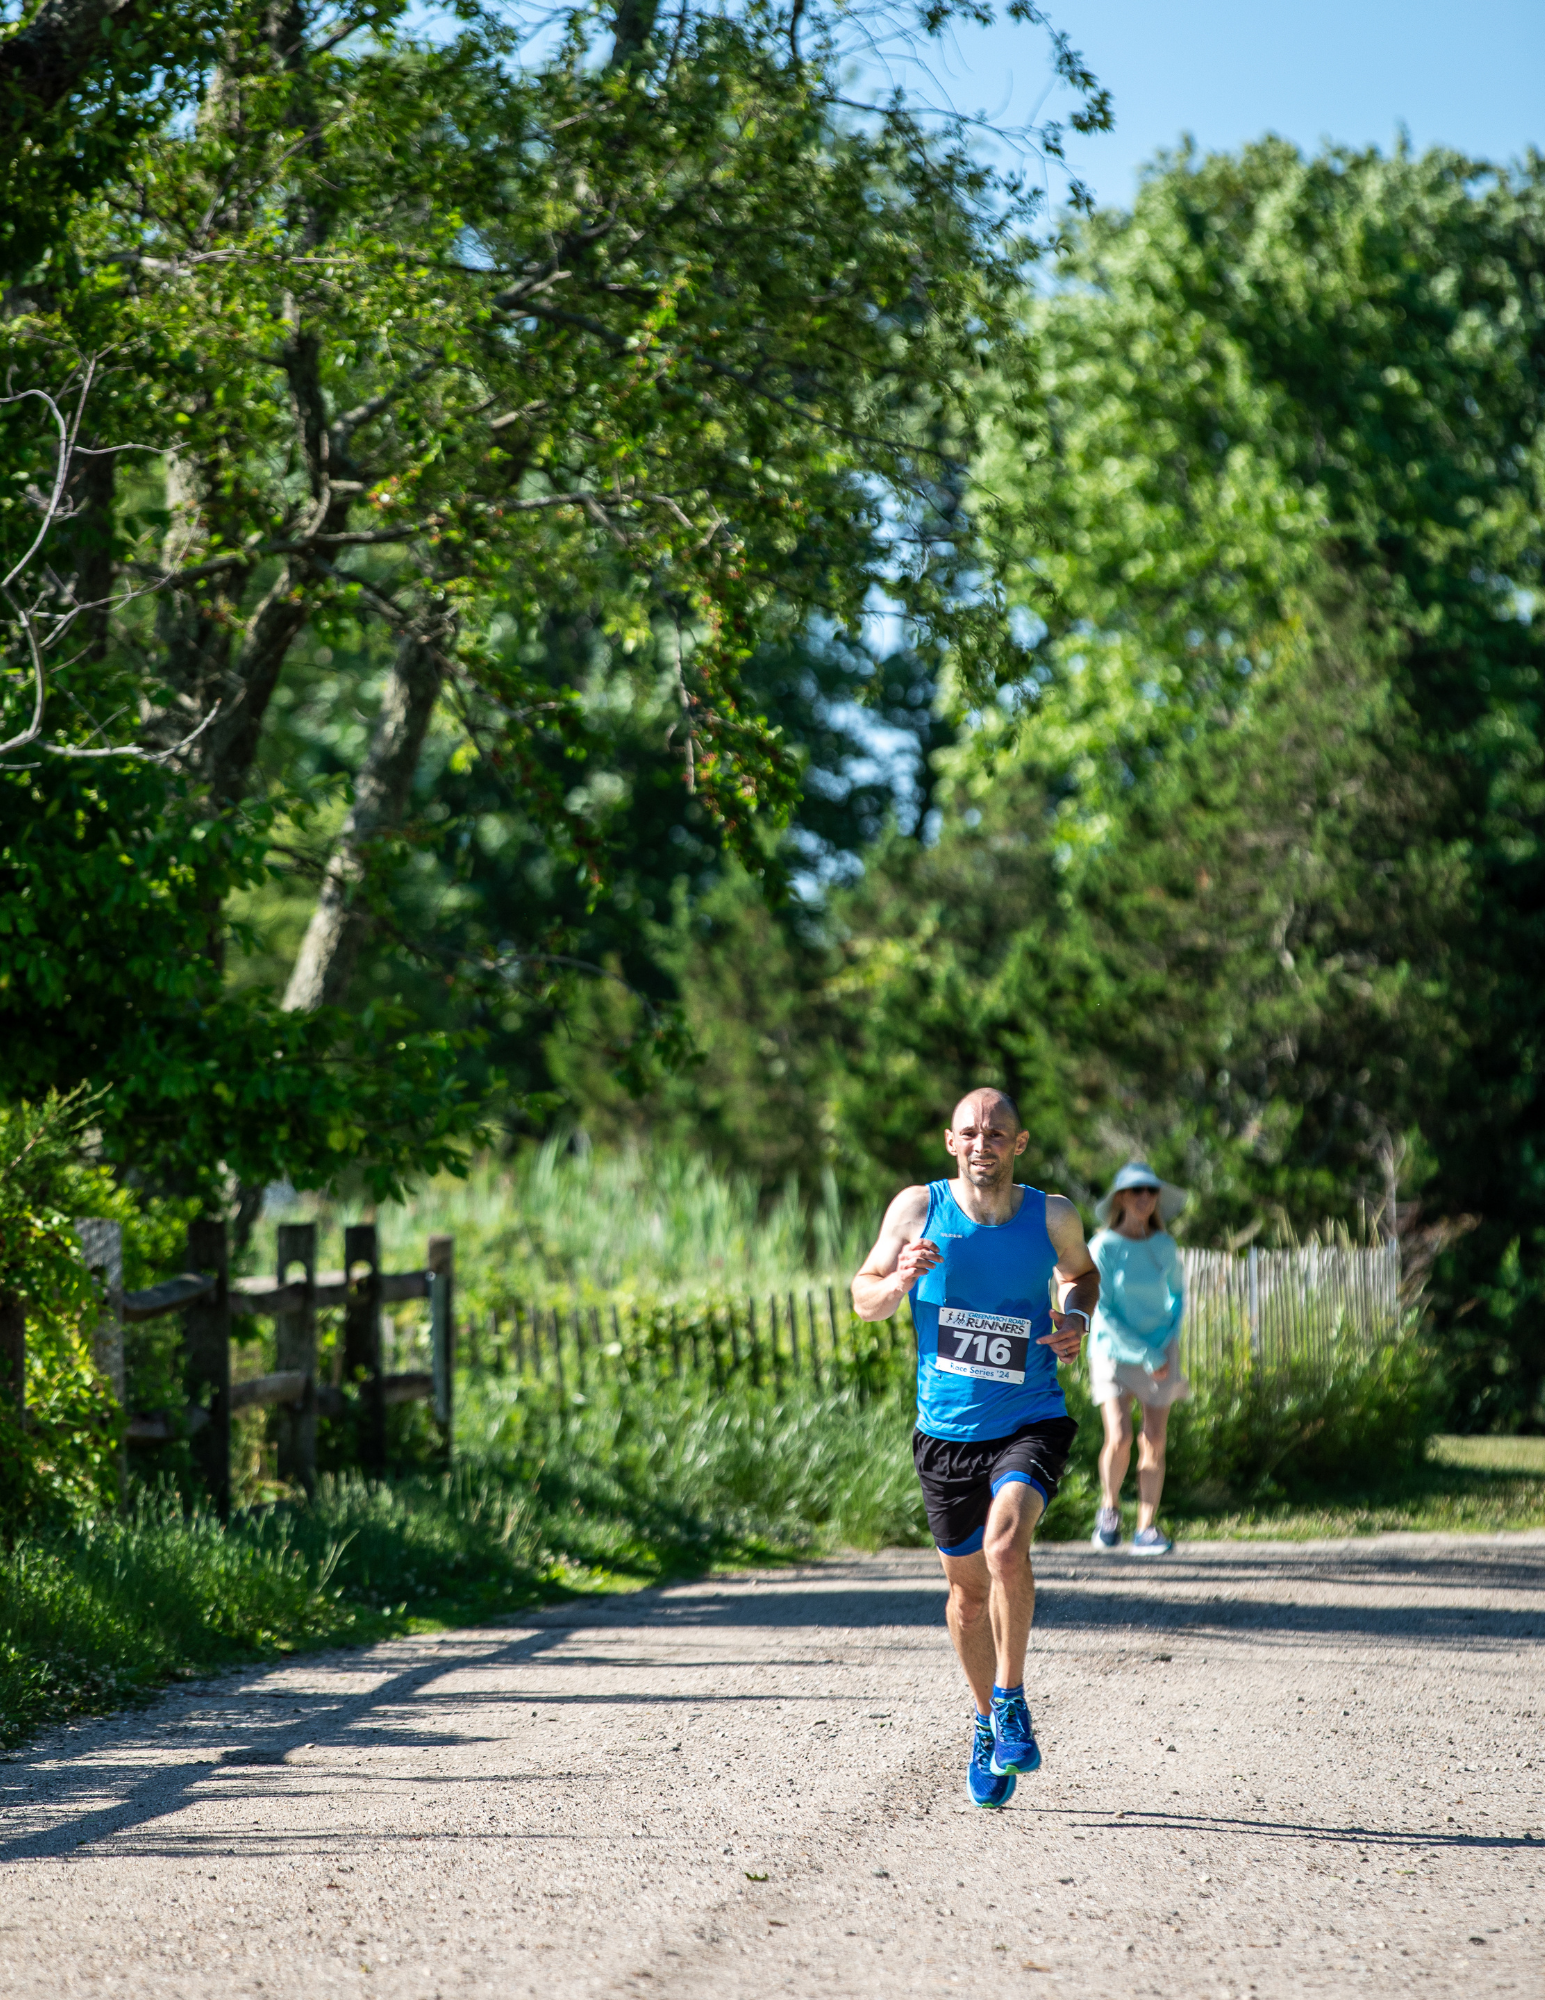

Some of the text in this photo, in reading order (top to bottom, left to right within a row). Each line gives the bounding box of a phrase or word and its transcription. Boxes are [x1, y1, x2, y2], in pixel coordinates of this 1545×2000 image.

[968, 1312, 1008, 1322] GREENWICH
[966, 1317, 1025, 1335] RUNNERS
[953, 1330, 1012, 1366] 716
[950, 1362, 967, 1372] Race
[969, 1366, 995, 1377] Series
[996, 1370, 1010, 1379] '24
